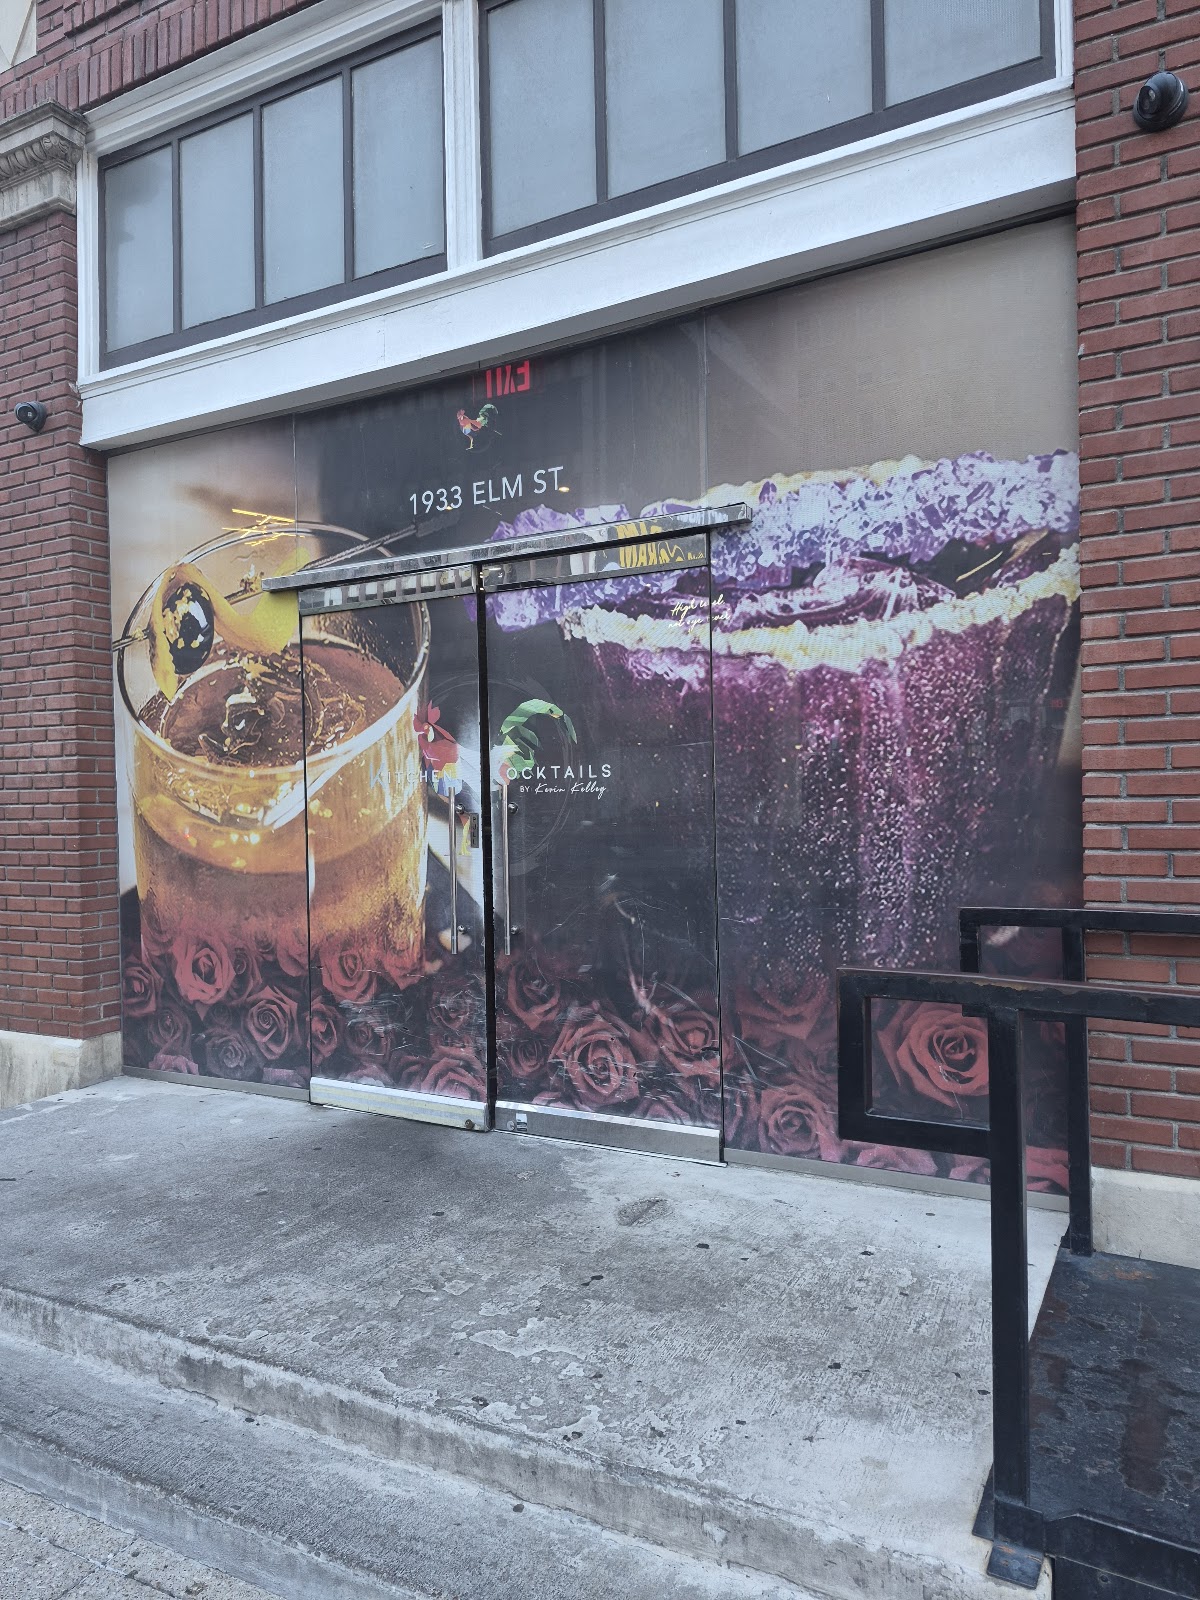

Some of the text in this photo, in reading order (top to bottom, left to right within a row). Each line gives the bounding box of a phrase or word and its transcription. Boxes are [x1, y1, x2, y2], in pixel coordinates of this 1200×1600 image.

[409, 465, 564, 516] 1933 ELM ST
[505, 763, 612, 781] OCKTAILS
